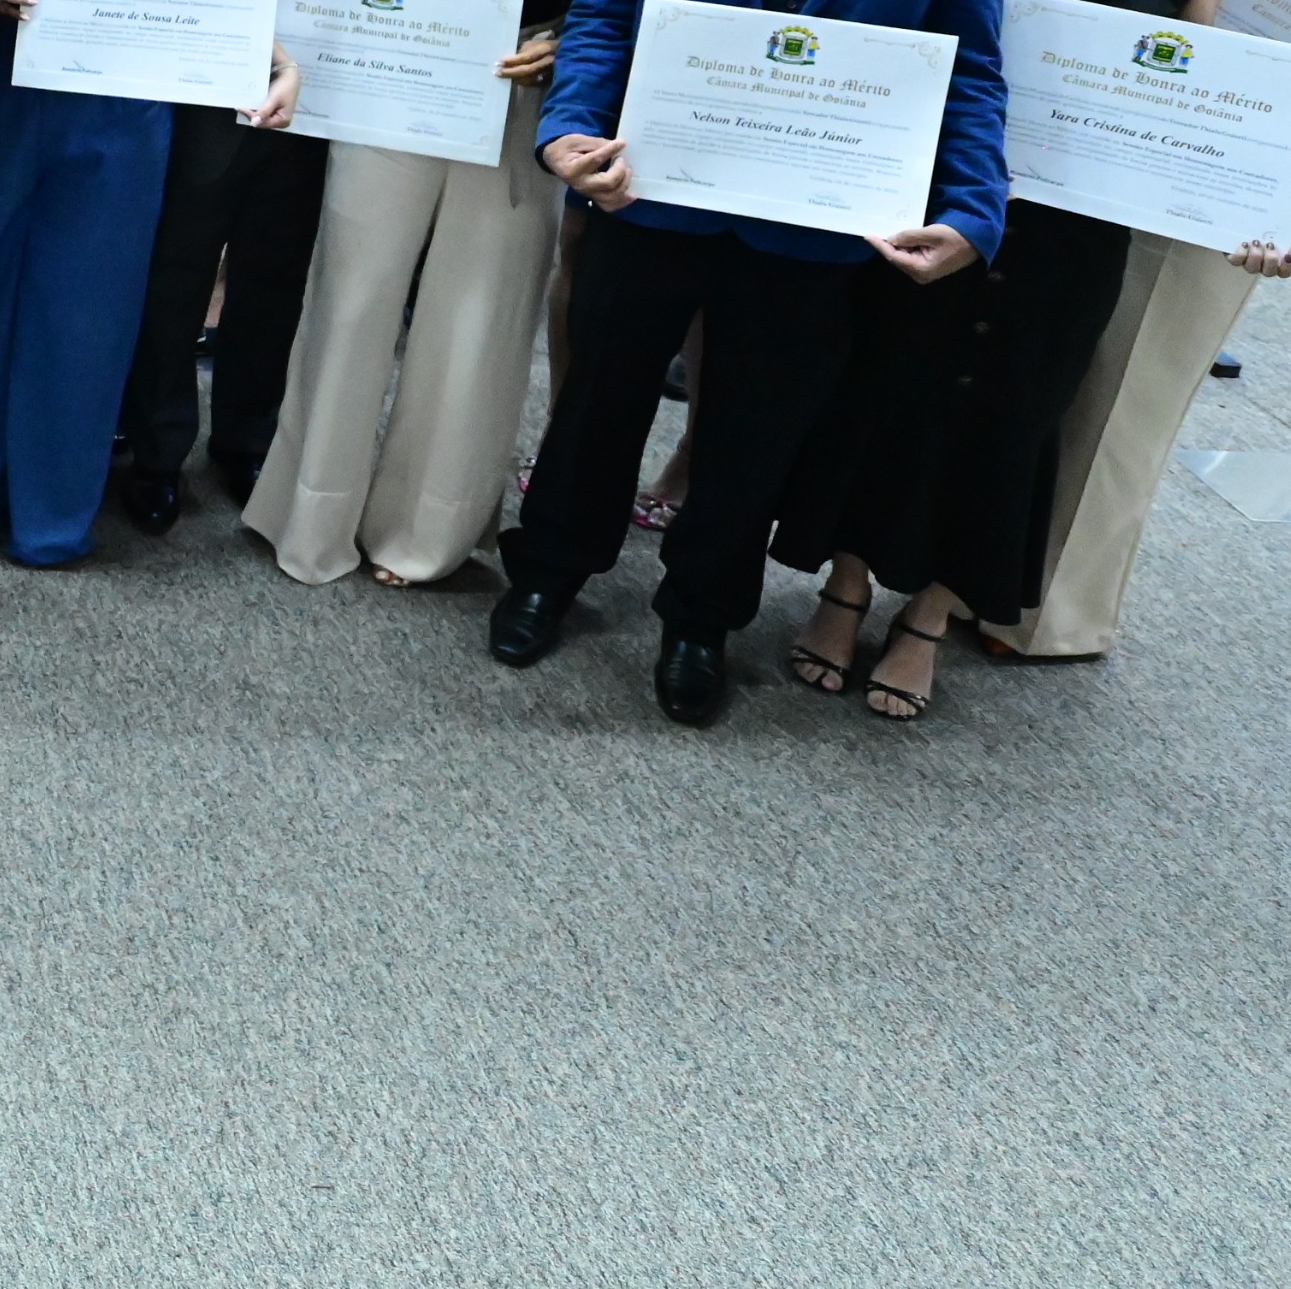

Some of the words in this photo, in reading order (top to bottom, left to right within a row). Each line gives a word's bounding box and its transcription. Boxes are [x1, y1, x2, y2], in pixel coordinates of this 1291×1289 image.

[92, 8, 125, 19] Janete
[127, 11, 139, 20] de
[141, 12, 172, 23] Sousa
[174, 14, 200, 25] Leite
[295, 1, 345, 18] Diploma
[348, 10, 361, 21] de
[366, 11, 405, 27] Honra
[408, 21, 423, 30] ao
[426, 21, 470, 37] Mérito
[316, 52, 350, 65] Eliane
[353, 58, 366, 67] da
[368, 60, 394, 72] Silva
[396, 64, 432, 77] Santos
[686, 55, 745, 75] Diploma
[749, 65, 764, 77] de
[770, 66, 815, 85] Honra
[818, 78, 836, 88] ao
[839, 78, 891, 97] Mérito
[1039, 50, 1107, 75] Diploma
[1111, 67, 1129, 80] de
[1135, 71, 1186, 93] Honra
[1190, 87, 1210, 98] ao
[1213, 90, 1273, 113] Mérito
[706, 75, 747, 90] Câmara
[750, 82, 805, 99] Municipal
[807, 91, 820, 101] de
[822, 93, 866, 108] Goiânia
[1061, 73, 1108, 92] Câmara
[1110, 85, 1174, 106] Municipal
[1176, 99, 1190, 110] de
[1193, 103, 1243, 122] Goiânia
[692, 110, 730, 125] Nelson
[735, 116, 782, 133] Teixeira
[785, 124, 816, 137] Leão
[818, 130, 862, 145] Júnior
[1050, 108, 1079, 123] Yara
[1083, 117, 1137, 137] Cristina
[1140, 130, 1157, 141] de
[1160, 135, 1225, 157] Carvalho
